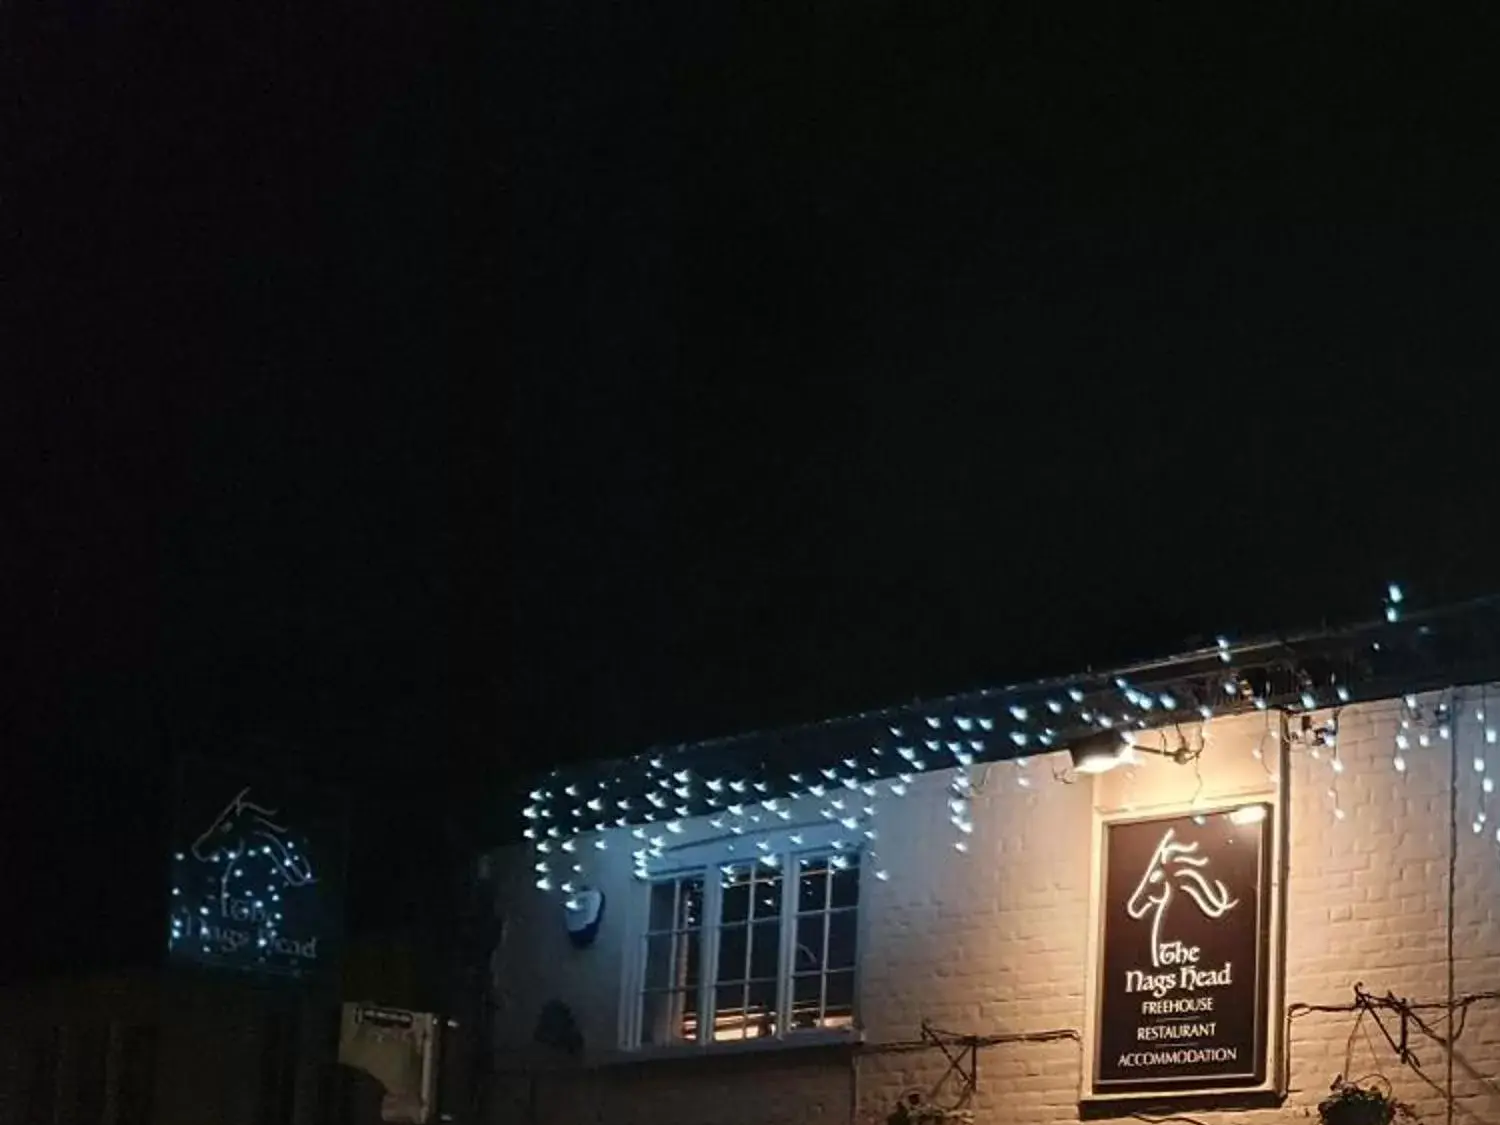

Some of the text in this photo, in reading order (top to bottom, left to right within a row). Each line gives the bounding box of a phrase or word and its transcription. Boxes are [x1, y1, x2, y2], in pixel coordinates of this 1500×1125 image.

[1159, 941, 1201, 966] The
[1141, 997, 1215, 1016] FREEHOUSE
[1136, 1022, 1217, 1041] RESTAURANT
[1117, 1047, 1238, 1068] ACCOMMODATION
